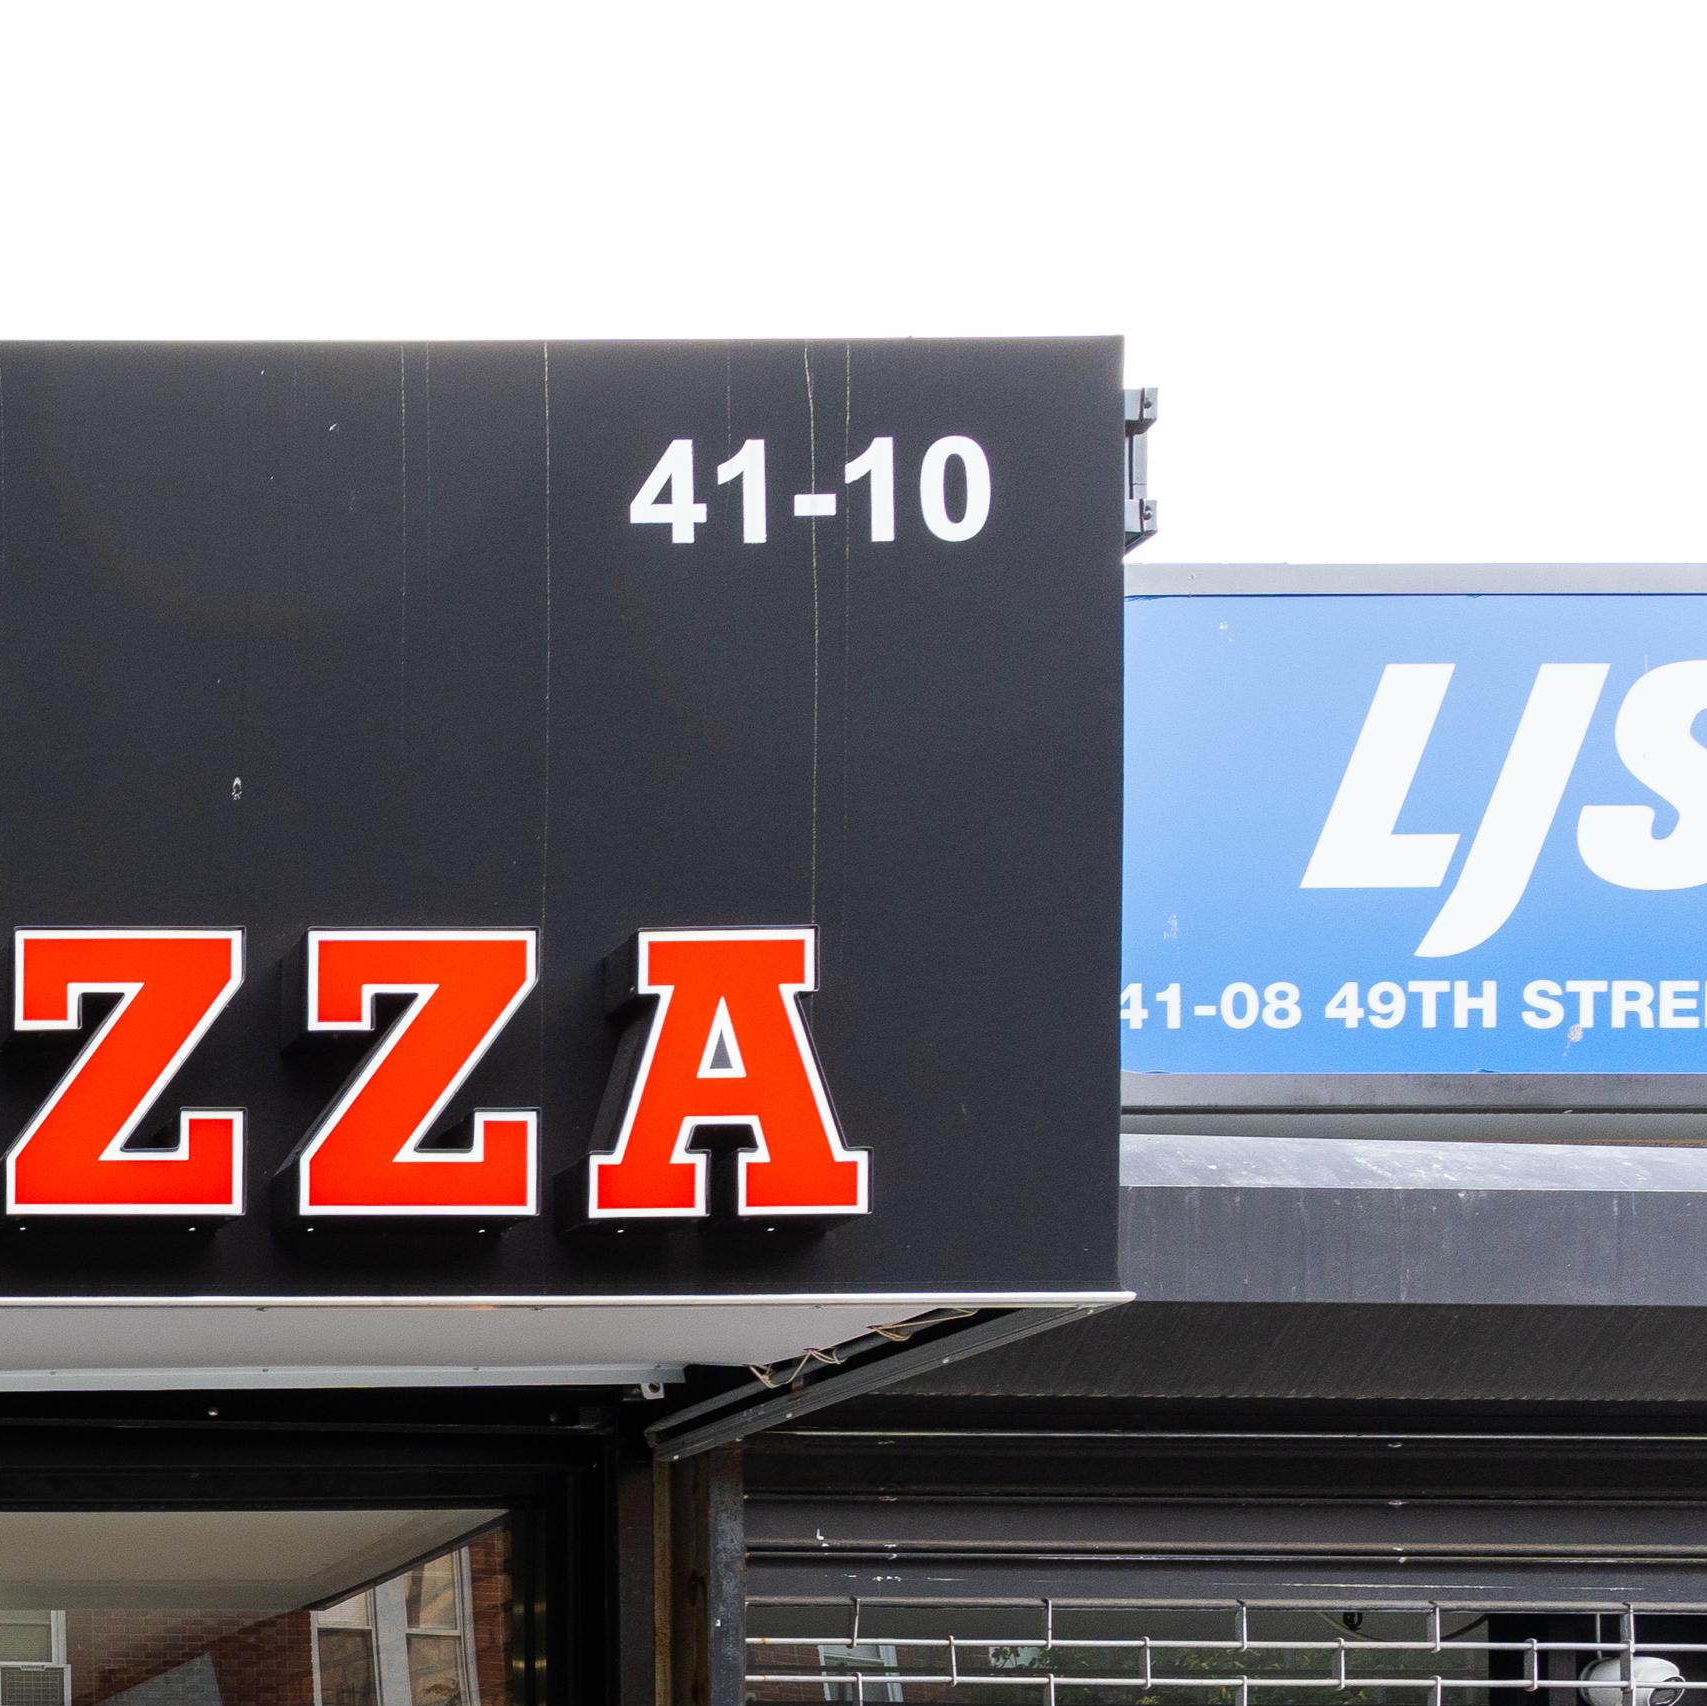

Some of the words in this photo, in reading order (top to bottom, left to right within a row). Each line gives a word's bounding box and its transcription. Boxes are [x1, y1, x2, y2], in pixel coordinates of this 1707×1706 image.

[628, 434, 993, 545] 41-10
[1120, 980, 1303, 1031] 41-08
[1324, 979, 1499, 1030] 49TH
[1520, 979, 1707, 1031] STRE
